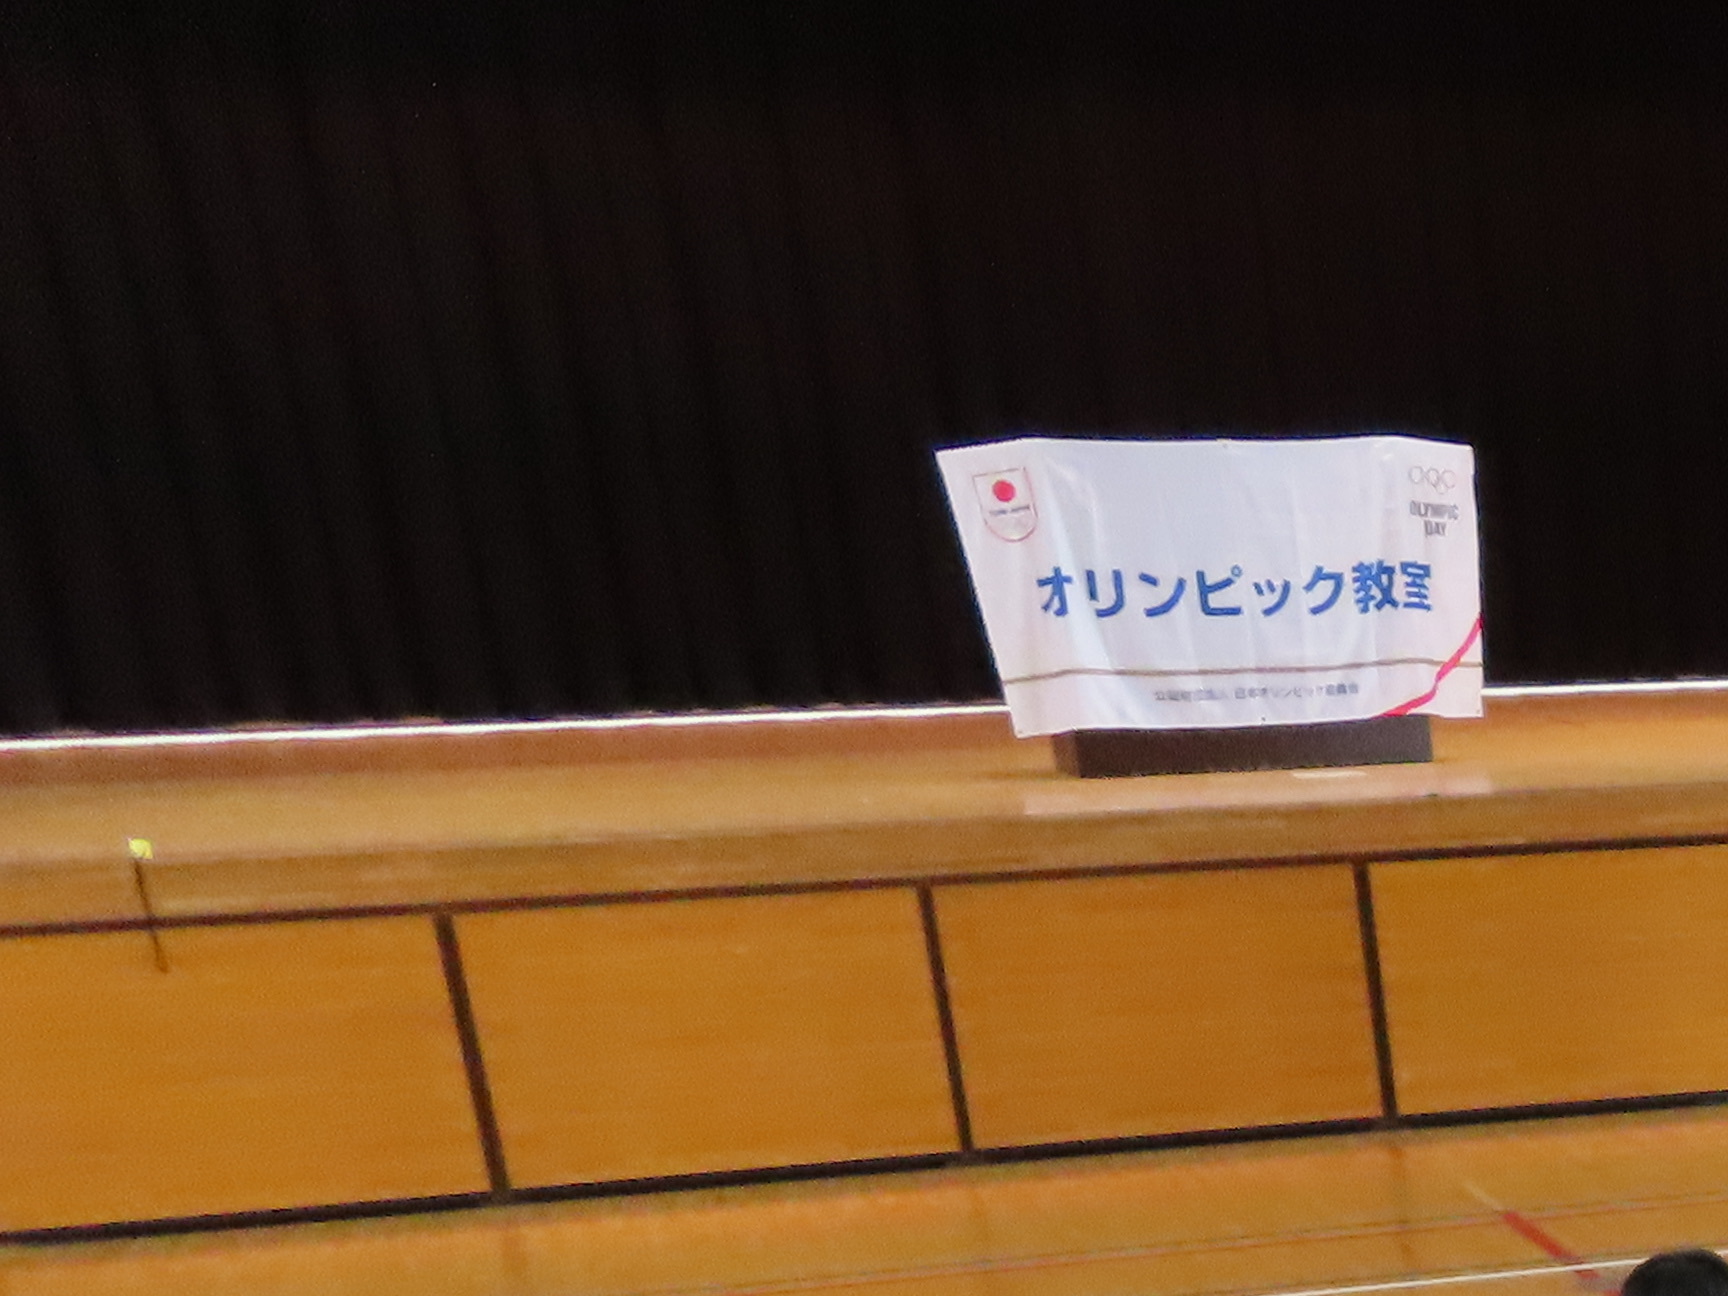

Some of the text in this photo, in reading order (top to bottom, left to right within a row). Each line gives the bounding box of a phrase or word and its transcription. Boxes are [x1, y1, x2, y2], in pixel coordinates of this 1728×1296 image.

[1036, 559, 1433, 617] オリンピック教室
